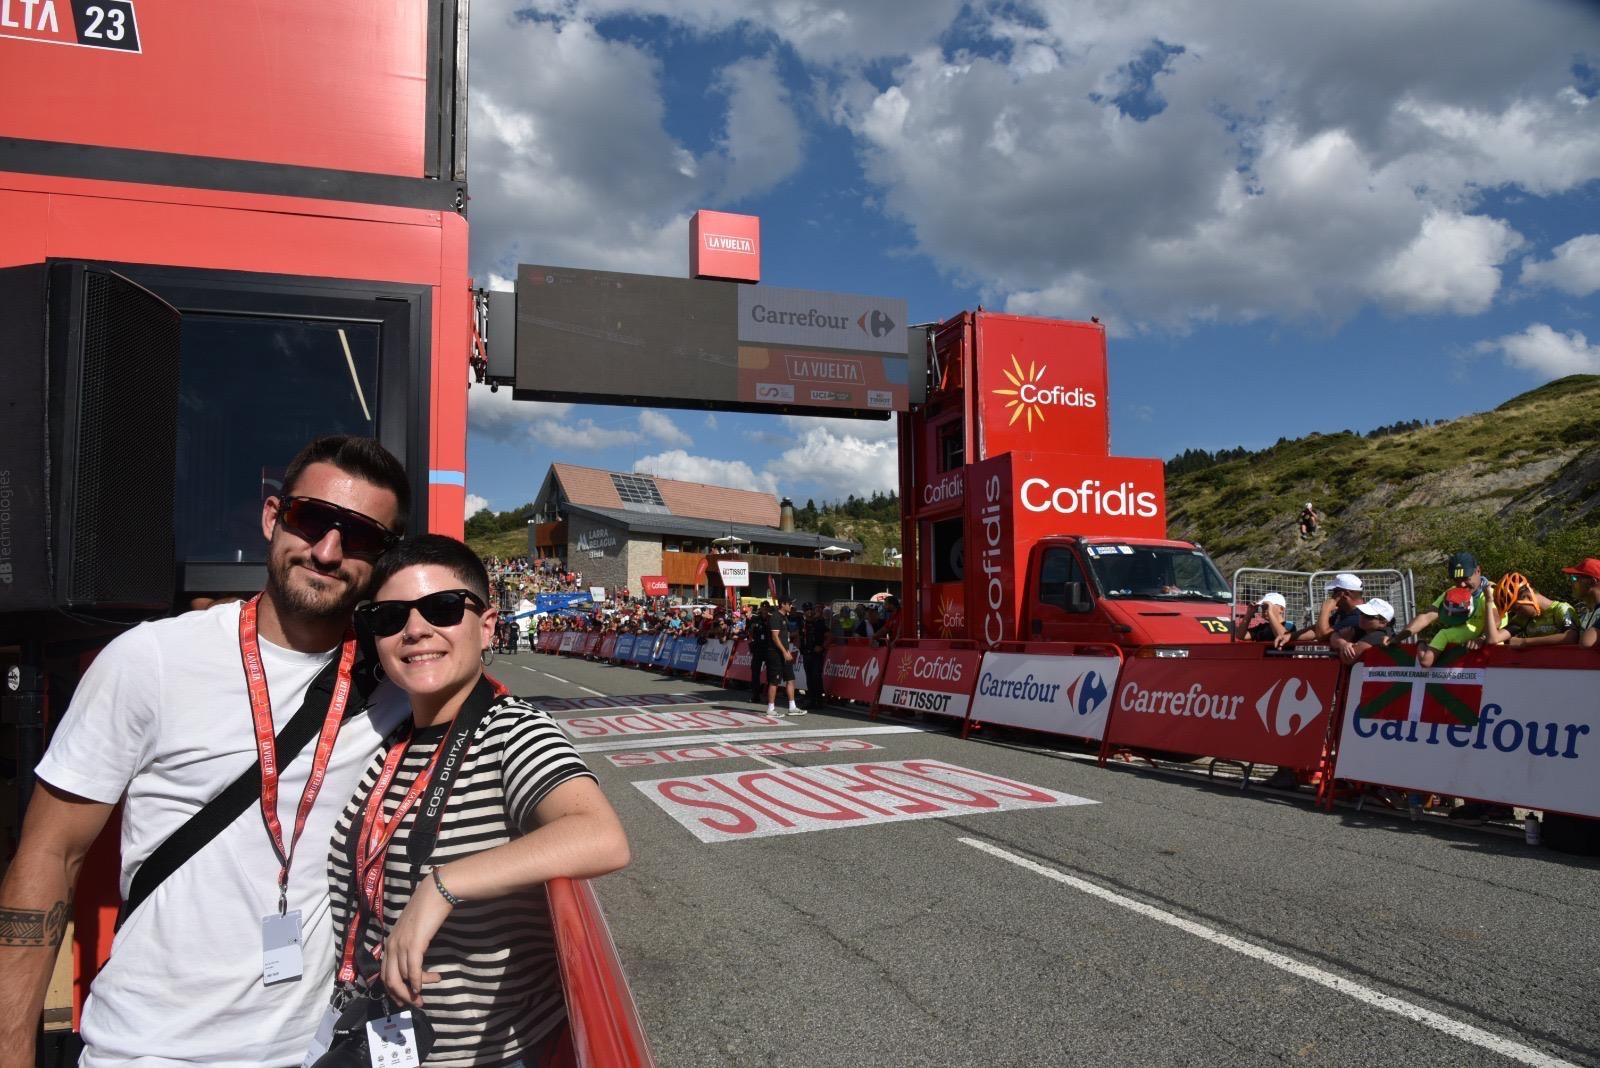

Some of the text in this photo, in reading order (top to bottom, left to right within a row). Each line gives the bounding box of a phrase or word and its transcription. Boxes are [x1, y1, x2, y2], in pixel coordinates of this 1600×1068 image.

[84, 6, 125, 41] 23
[720, 238, 750, 252] VUELTA
[752, 304, 849, 330] Carrefour
[811, 361, 858, 380] VUELTA
[1020, 384, 1097, 408] Cofidis
[1020, 478, 1158, 517] Cofidis
[589, 527, 608, 539] LARRA
[589, 536, 616, 549] BELAGUA
[730, 568, 747, 576] TISSOT
[982, 475, 1003, 647] Cofidis
[1200, 620, 1228, 632] 73
[823, 658, 860, 679] Carrefour
[913, 656, 963, 681] Cofidis
[1457, 672, 1477, 680] DECIDE
[336, 681, 348, 702] VUELTA
[980, 672, 1060, 703] Carrefour
[909, 691, 951, 712] TISSOT
[1120, 681, 1244, 720] Carrefour
[566, 710, 779, 736] COFIDIS
[263, 750, 273, 775] VUELTA
[610, 740, 874, 766] COFIDIS
[309, 770, 323, 794] VUELTA
[427, 729, 469, 817] EOS DIGITAL
[657, 761, 1058, 834] COFIDIS
[342, 963, 353, 981] ELTA
